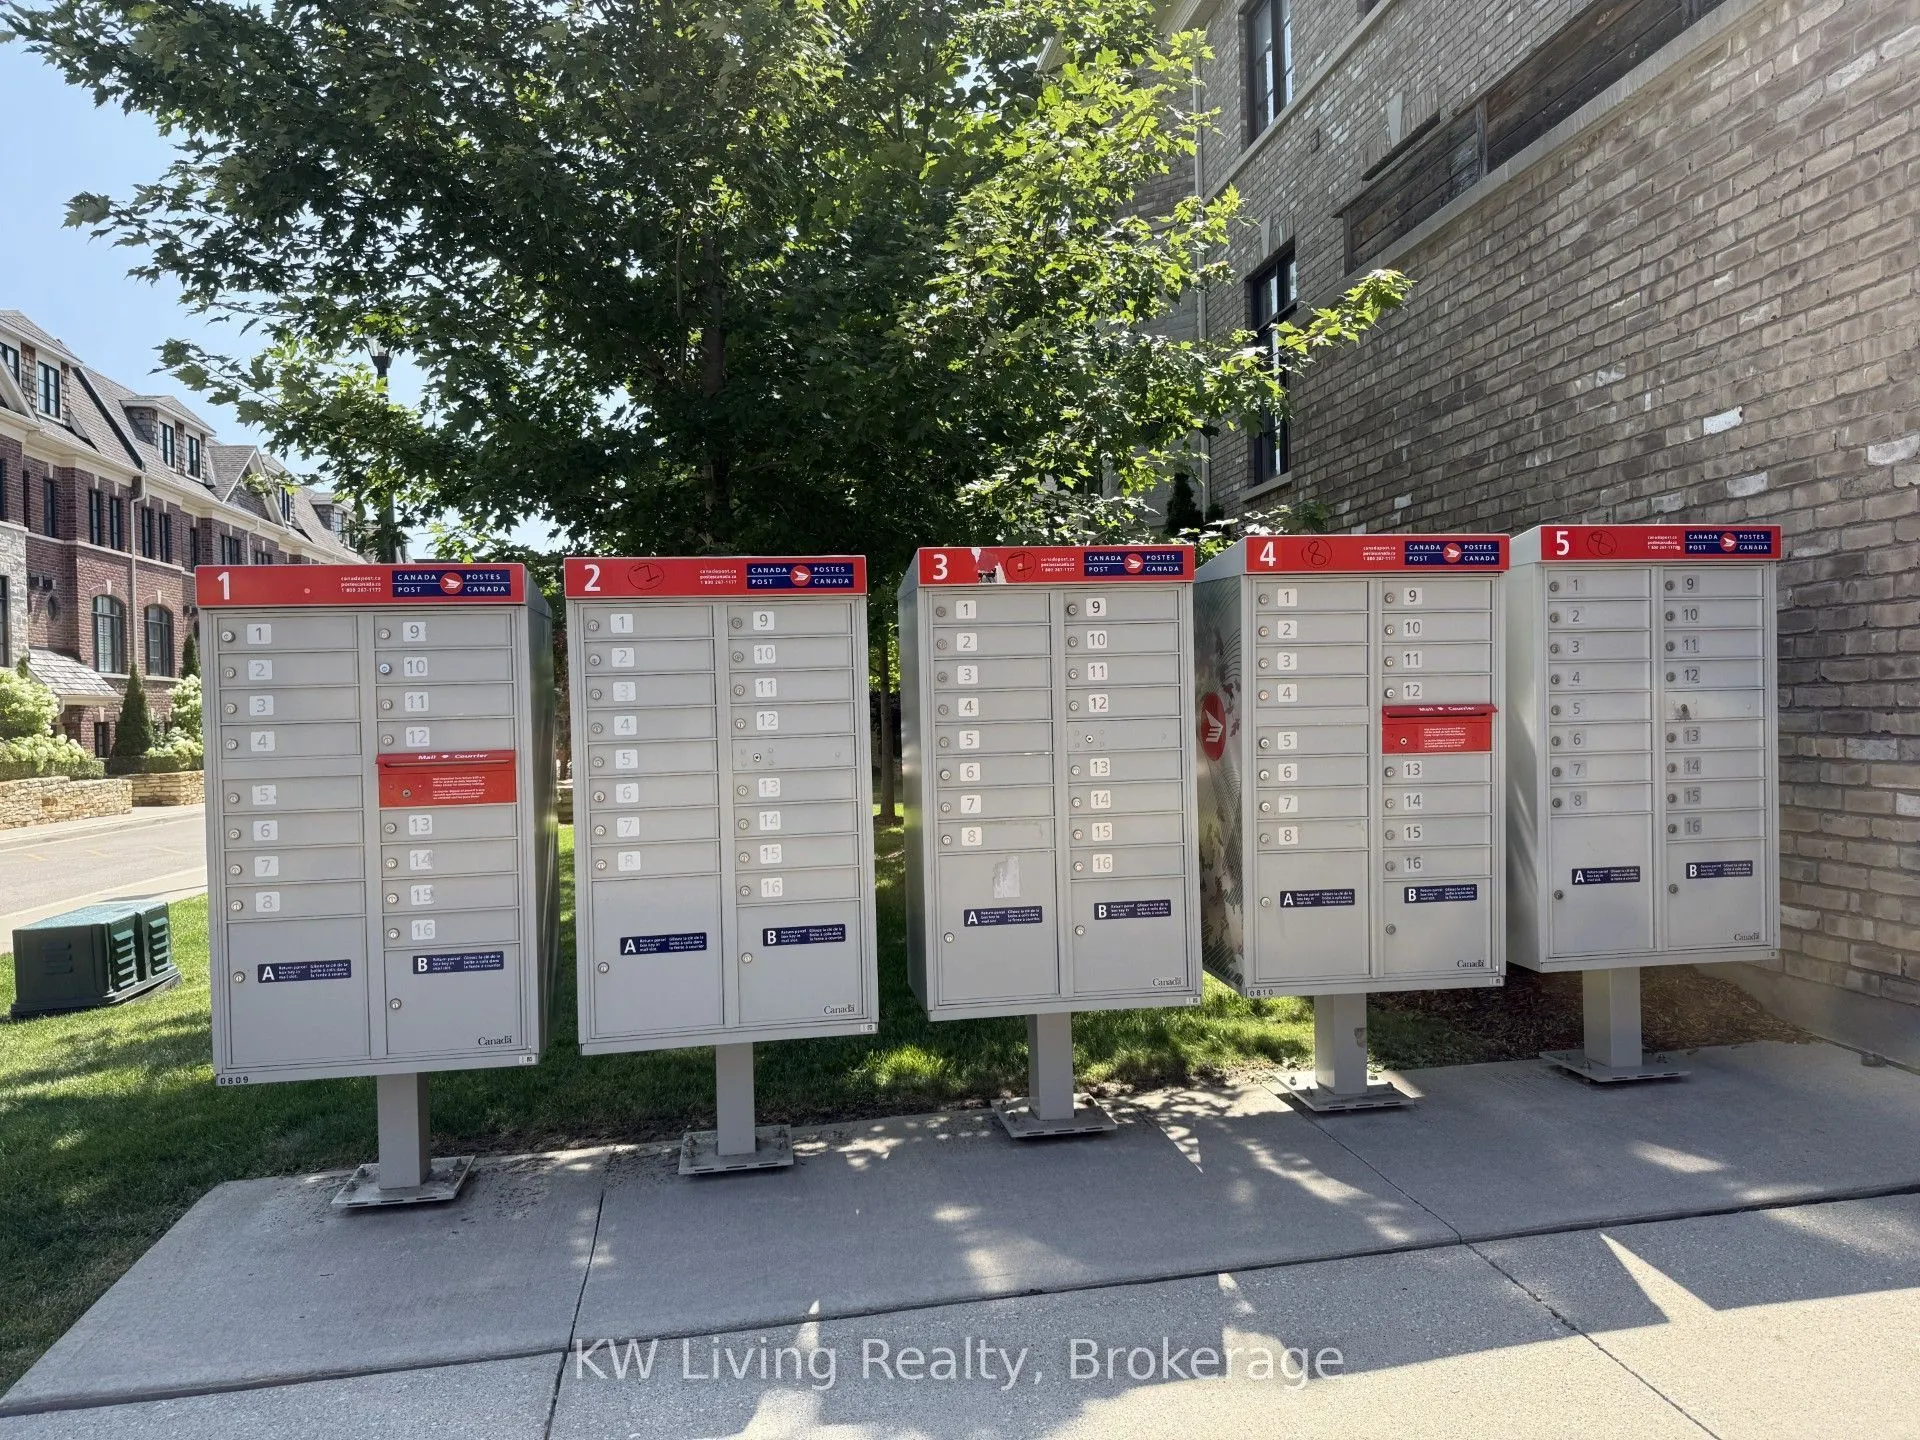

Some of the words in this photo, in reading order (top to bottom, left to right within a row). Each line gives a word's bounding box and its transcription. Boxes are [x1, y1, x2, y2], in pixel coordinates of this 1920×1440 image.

[1556, 531, 1569, 555] 5
[1260, 542, 1276, 566] 4
[933, 554, 948, 579] 3
[584, 564, 600, 591] 2
[1686, 578, 1694, 590] 9
[218, 572, 230, 600] 1
[1573, 579, 1578, 590] 1
[1284, 592, 1290, 604] 1
[1408, 590, 1417, 602] 9
[962, 604, 969, 616] 1
[1092, 601, 1100, 614] 9
[1684, 608, 1698, 620] 10
[619, 616, 626, 628] 1
[760, 614, 768, 628] 9
[1572, 610, 1580, 623] 2
[255, 628, 262, 641] 1
[410, 624, 420, 639] 9
[1283, 623, 1291, 636] 2
[1405, 622, 1421, 634] 10
[962, 636, 971, 648] 2
[1090, 633, 1106, 646] 10
[1572, 640, 1580, 652] 3
[1684, 639, 1697, 651] 11
[618, 650, 628, 664] 2
[756, 647, 774, 660] 10
[1405, 653, 1419, 666] 11
[407, 660, 426, 674] 10
[1283, 655, 1291, 668] 3
[256, 663, 265, 677] 2
[964, 668, 972, 681] 3
[1090, 666, 1105, 678] 11
[1684, 669, 1698, 681] 12
[1572, 672, 1580, 684] 4
[758, 681, 774, 694] 11
[1282, 686, 1292, 699] 4
[1405, 684, 1420, 697] 12
[256, 698, 266, 712] 3
[408, 695, 424, 708] 11
[964, 700, 973, 713] 4
[1090, 697, 1107, 710] 12
[1573, 703, 1580, 715] 5
[620, 718, 630, 731] 4
[760, 714, 776, 726] 12
[256, 734, 268, 748] 4
[409, 730, 428, 744] 12
[966, 733, 974, 746] 5
[1283, 734, 1291, 747] 5
[1573, 733, 1581, 745] 6
[1684, 730, 1698, 742] 13
[622, 752, 631, 766] 5
[966, 766, 974, 778] 6
[1092, 761, 1108, 773] 13
[1284, 766, 1292, 778] 6
[1405, 763, 1420, 776] 13
[1573, 764, 1581, 776] 7
[1685, 760, 1700, 772] 14
[622, 786, 632, 799] 6
[760, 781, 778, 794] 13
[260, 788, 269, 802] 5
[1093, 793, 1110, 806] 14
[1405, 795, 1421, 807] 14
[1574, 794, 1582, 806] 8
[1686, 790, 1700, 802] 15
[966, 798, 975, 810] 7
[1284, 798, 1292, 810] 7
[412, 818, 430, 832] 13
[623, 820, 633, 833] 7
[761, 814, 778, 827] 14
[1686, 820, 1700, 832] 16
[260, 824, 270, 838] 6
[968, 830, 976, 842] 8
[1094, 825, 1110, 838] 15
[1284, 830, 1292, 842] 8
[1406, 826, 1421, 839] 15
[412, 853, 432, 867] 14
[762, 847, 780, 860] 15
[262, 860, 271, 874] 7
[1095, 857, 1111, 869] 16
[1406, 857, 1422, 870] 16
[1574, 870, 1584, 883] A
[1689, 865, 1697, 877] B
[764, 881, 780, 894] 16
[1283, 893, 1294, 906] A
[1408, 889, 1417, 902] B
[967, 911, 978, 924] A
[1098, 905, 1107, 918] B
[415, 923, 434, 937] 16
[767, 930, 777, 944] B
[1734, 932, 1760, 942] Canada
[624, 939, 636, 953] A
[417, 957, 428, 972] B
[1456, 959, 1485, 968] Canada
[262, 966, 275, 981] A
[1152, 977, 1182, 987] Canada
[823, 1003, 855, 1014] Canada
[478, 1035, 512, 1047] Canada
[220, 1076, 249, 1085] 0809
